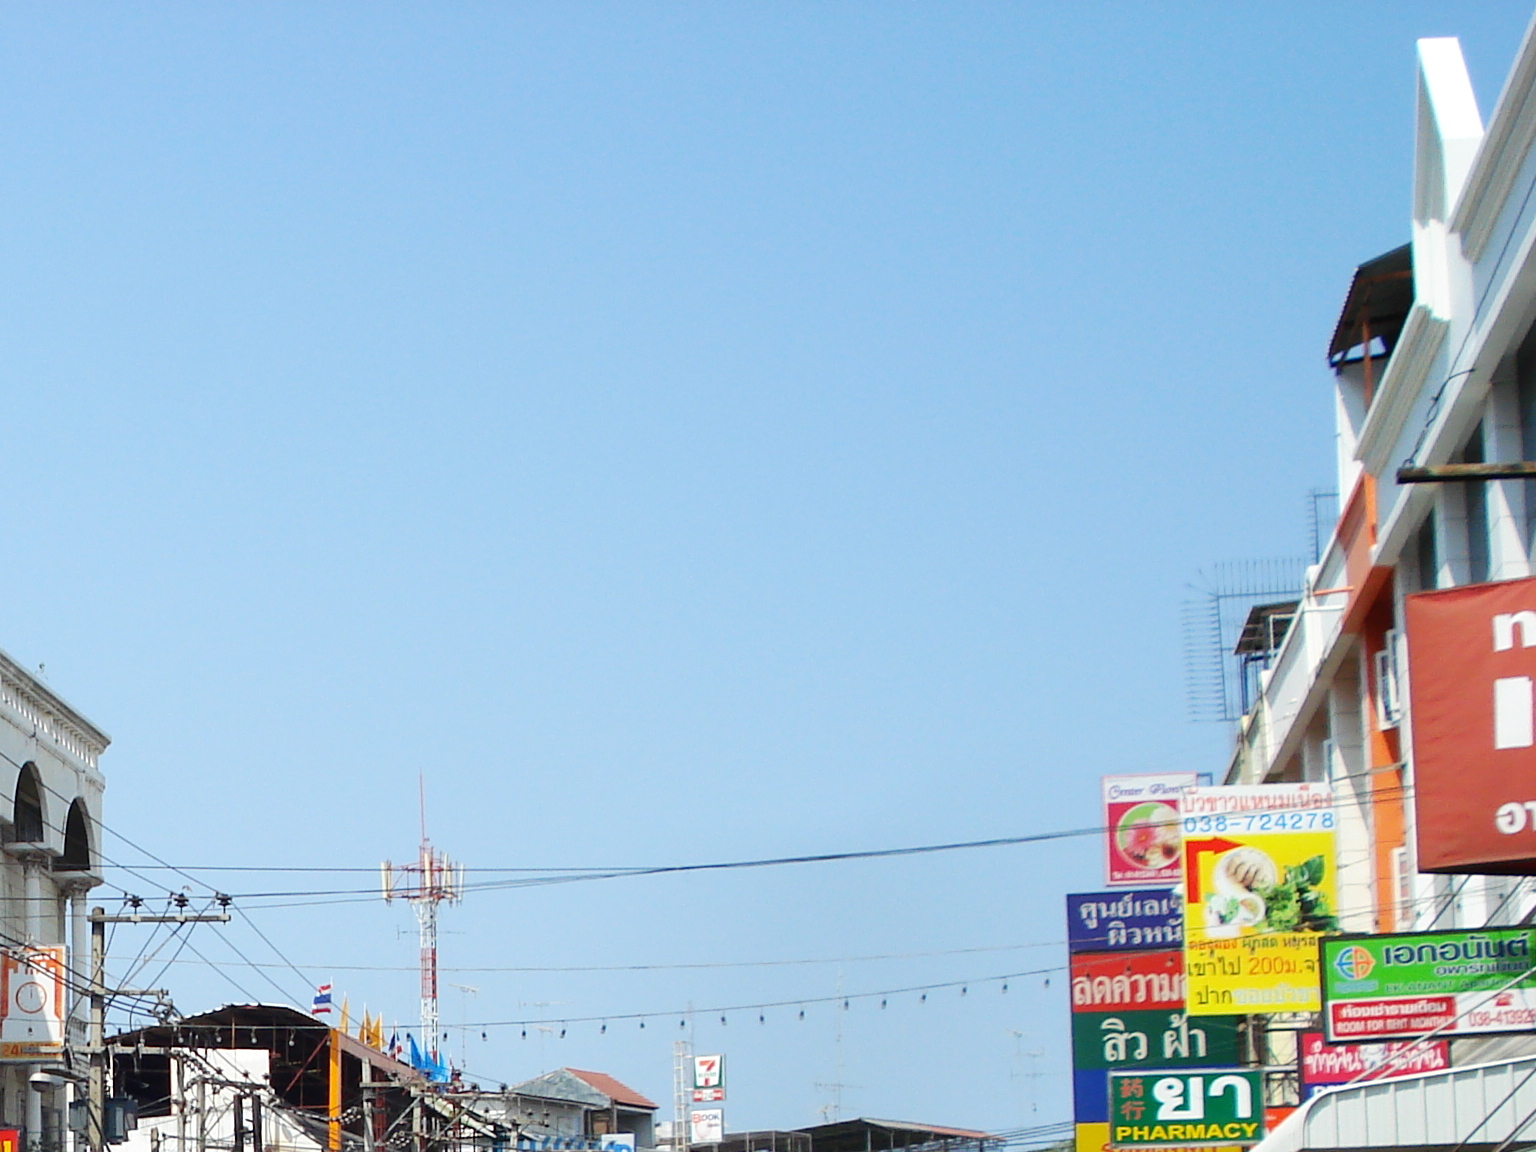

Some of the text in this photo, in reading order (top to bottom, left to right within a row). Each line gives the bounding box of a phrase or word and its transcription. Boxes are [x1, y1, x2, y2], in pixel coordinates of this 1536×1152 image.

[1183, 812, 1335, 832] 038-724278
[1384, 932, 1531, 965] เอกอนันต์
[1100, 1013, 1208, 1062] สิว ฝ้า
[1152, 1074, 1252, 1121] ยา
[1116, 1122, 1259, 1141] PHARMACY
